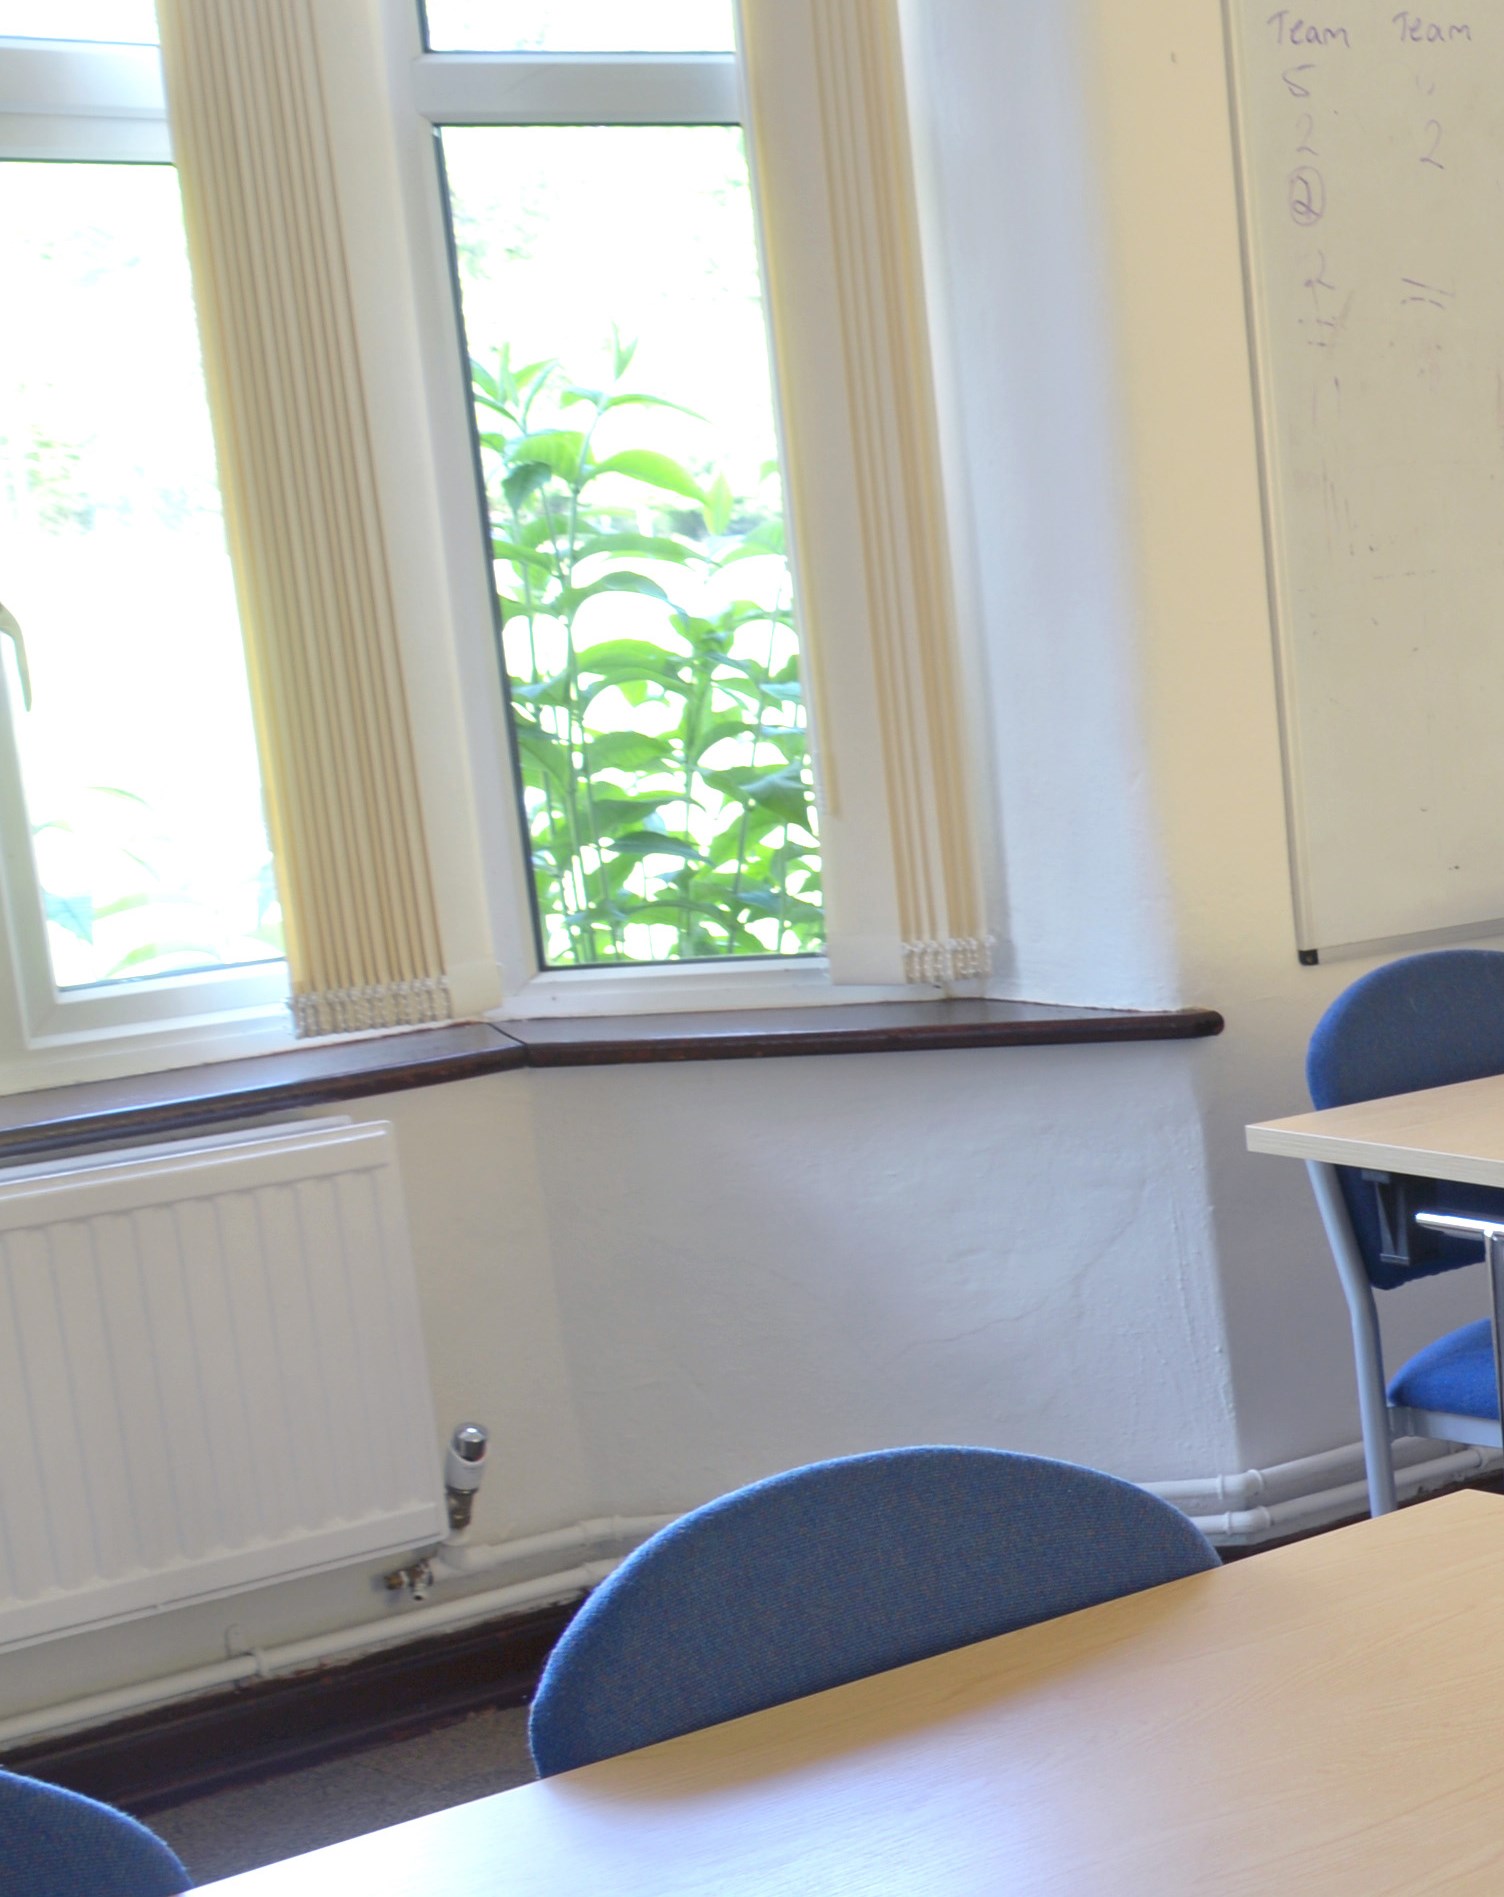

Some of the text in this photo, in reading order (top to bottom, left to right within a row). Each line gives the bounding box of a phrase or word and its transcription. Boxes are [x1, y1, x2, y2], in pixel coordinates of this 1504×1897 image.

[1267, 10, 1349, 48] Team
[1393, 11, 1471, 42] Team
[1420, 119, 1444, 169] 2
